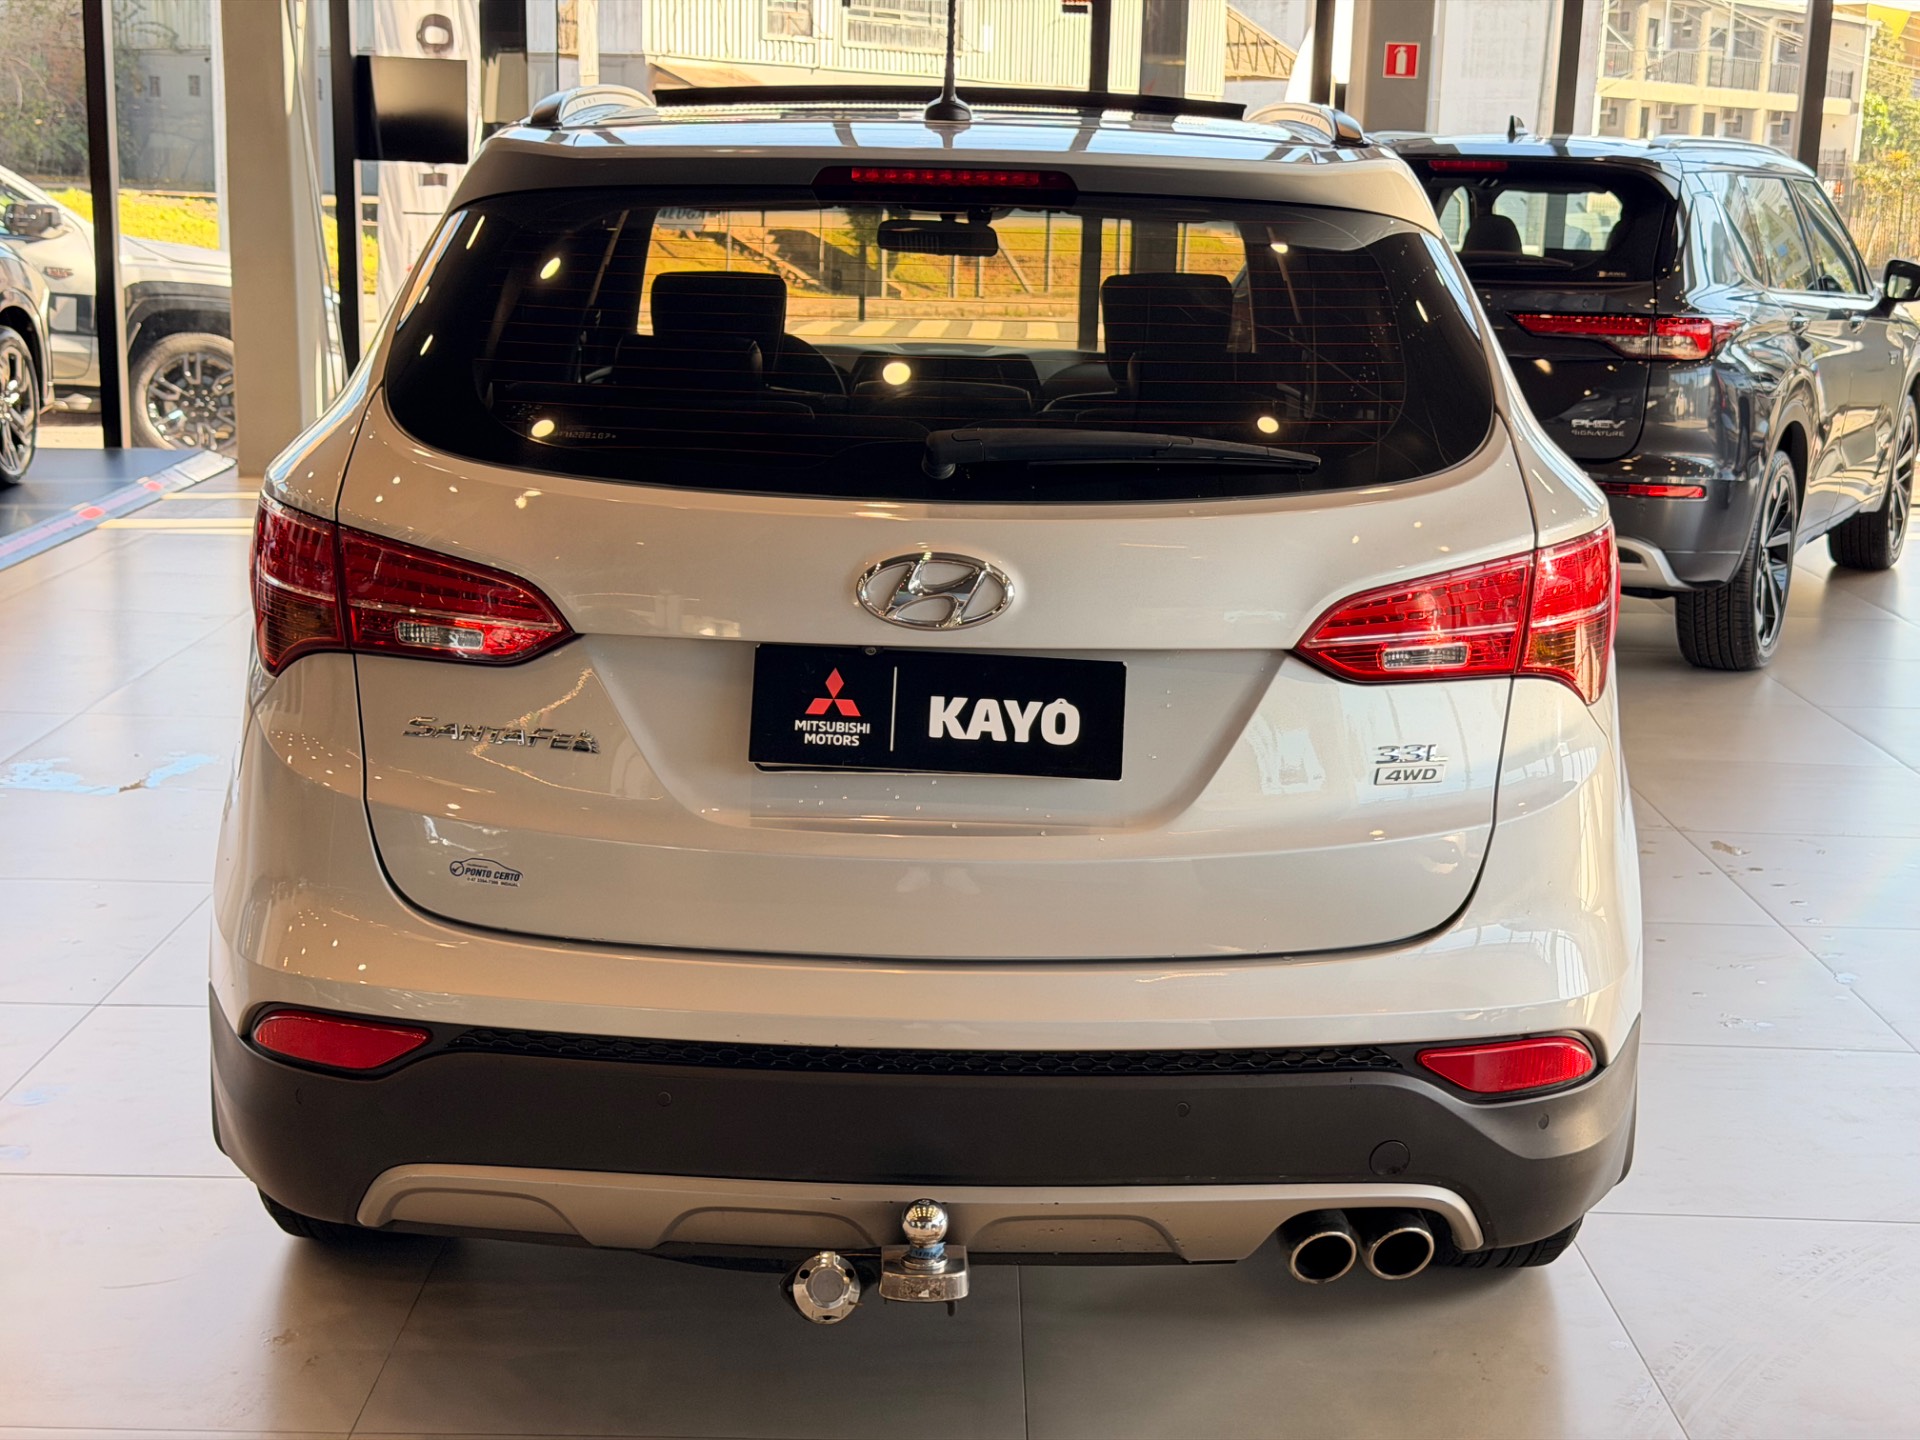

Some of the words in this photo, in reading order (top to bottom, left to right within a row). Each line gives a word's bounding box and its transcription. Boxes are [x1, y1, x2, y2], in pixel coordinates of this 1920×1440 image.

[1571, 429, 1625, 437] SIGNATURE
[794, 719, 871, 735] MITSUBISHI
[928, 695, 1081, 746] KAYÔ
[803, 732, 861, 747] MOTORS
[1384, 768, 1437, 782] 4WD
[464, 866, 493, 879] PONTO
[493, 870, 521, 882] CERTO
